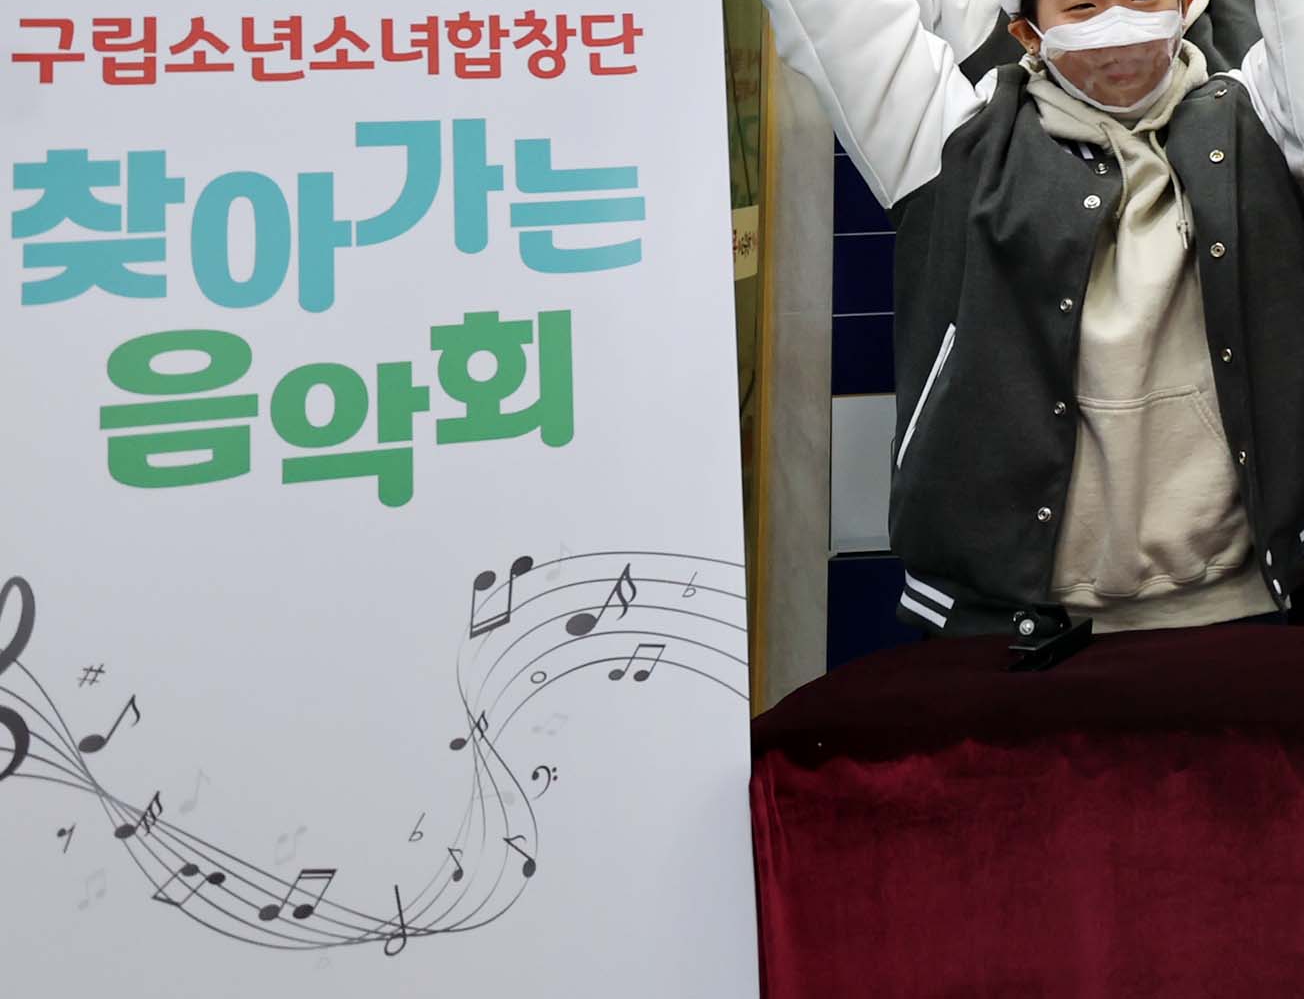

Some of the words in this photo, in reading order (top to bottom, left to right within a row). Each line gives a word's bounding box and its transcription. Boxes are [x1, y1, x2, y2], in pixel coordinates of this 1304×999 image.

[11, 9, 645, 87] 구립소년소녀합창단
[10, 117, 647, 314] 찾아가는
[98, 308, 576, 509] 음악회
